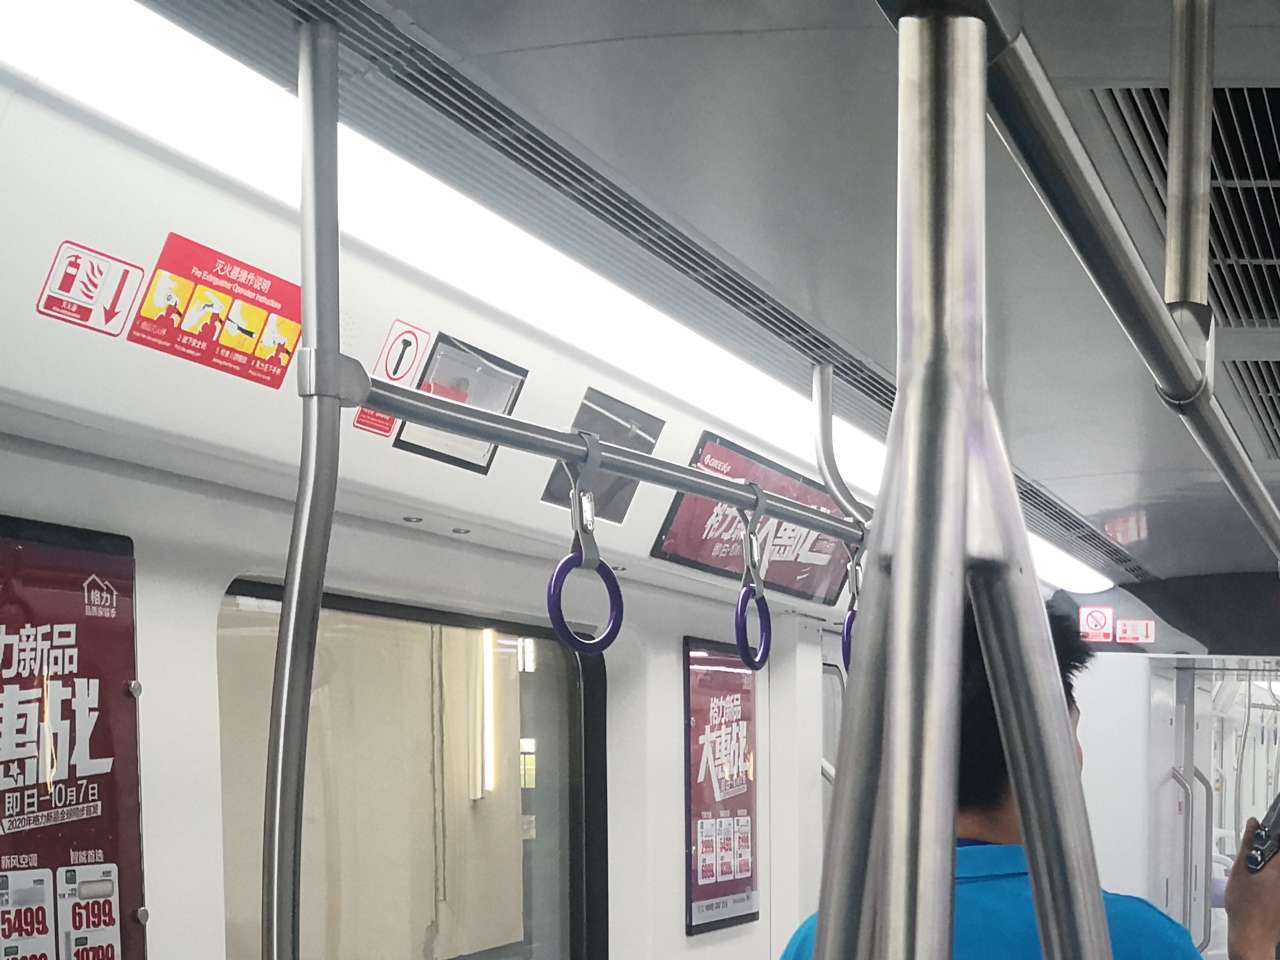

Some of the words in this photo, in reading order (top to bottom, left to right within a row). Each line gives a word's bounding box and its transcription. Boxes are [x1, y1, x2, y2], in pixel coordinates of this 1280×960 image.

[0, 677, 114, 792] 惠战
[0, 906, 48, 940] 5499
[72, 900, 115, 931] 6199
